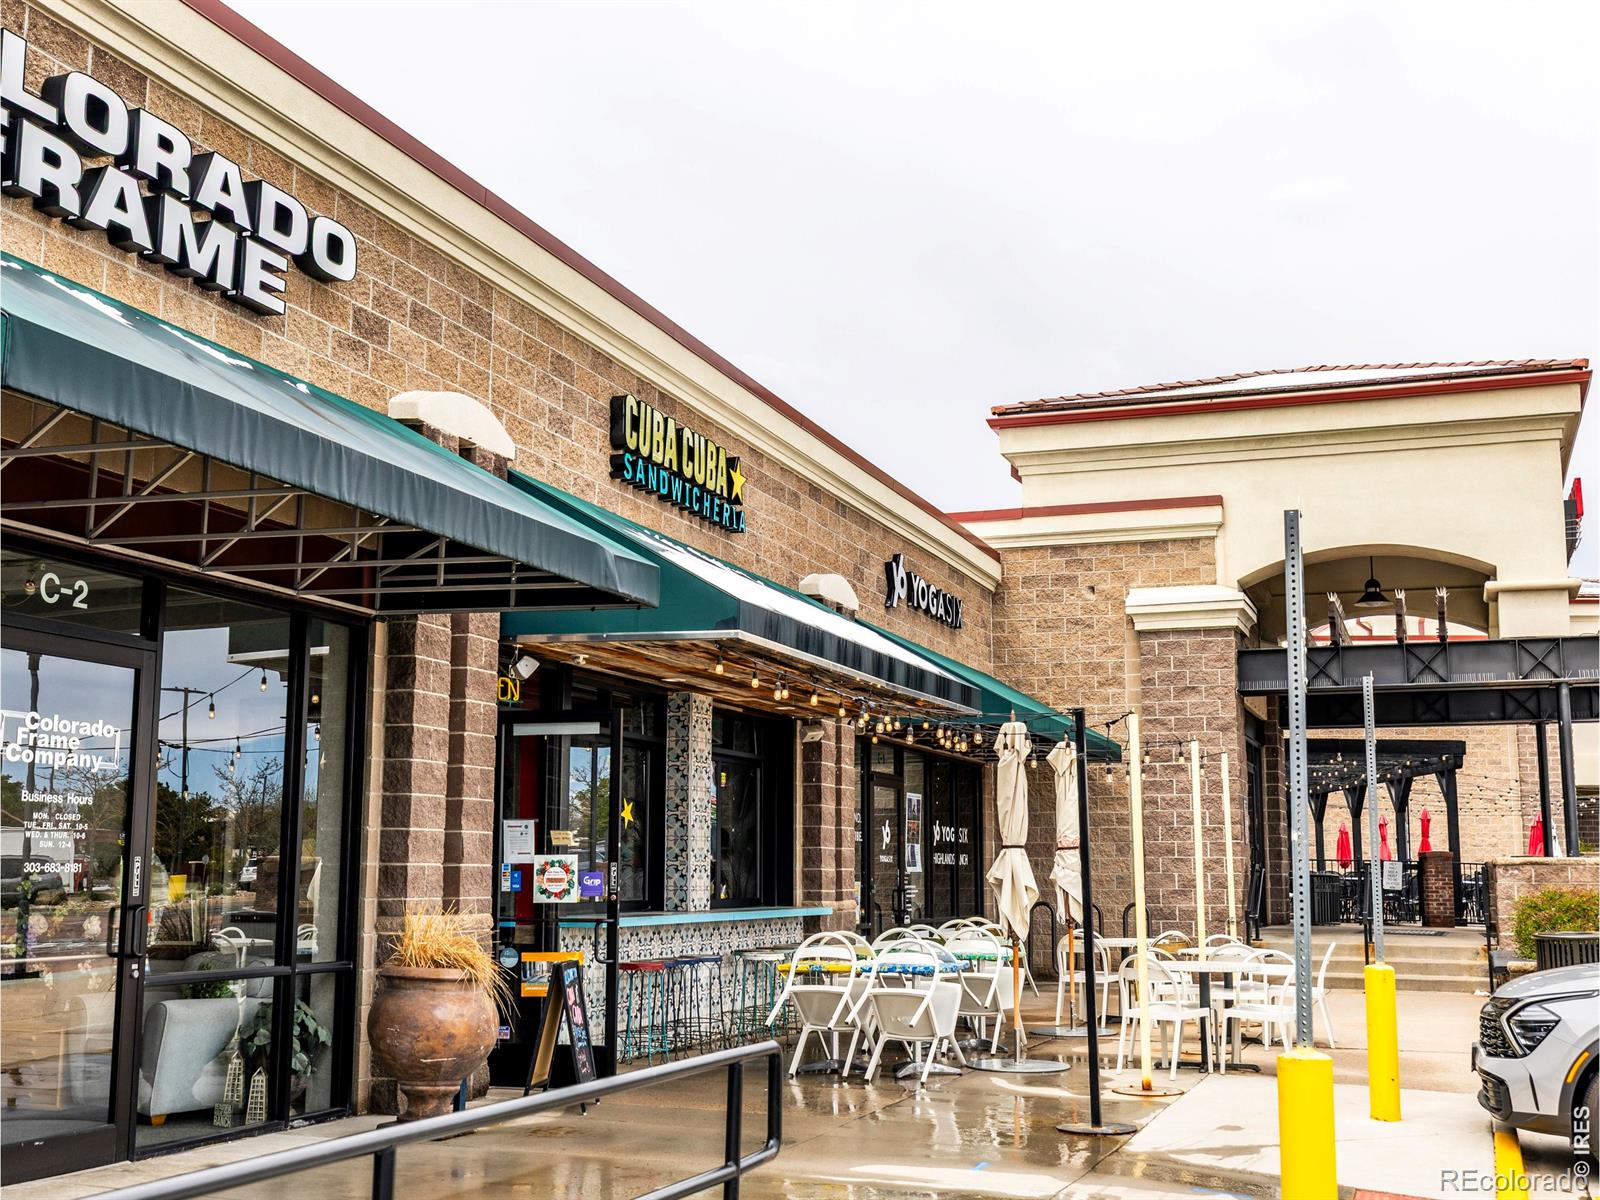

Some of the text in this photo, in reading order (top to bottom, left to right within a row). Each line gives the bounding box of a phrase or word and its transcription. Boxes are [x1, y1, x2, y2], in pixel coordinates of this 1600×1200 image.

[0, 107, 288, 316] RAME
[625, 394, 728, 498] CUBA CUBA
[623, 452, 746, 533] SANDWICHERIA
[40, 572, 89, 610] C-2
[911, 572, 964, 628] YOGASIX
[497, 677, 520, 701] EN
[25, 711, 116, 738] Colorado
[17, 727, 80, 750] Frame
[5, 743, 103, 773] Company
[21, 790, 94, 806] Business Hours
[32, 812, 81, 821] MON. CLOSED
[941, 826, 969, 843] YOGSIX
[23, 862, 83, 873] 303-683-8181
